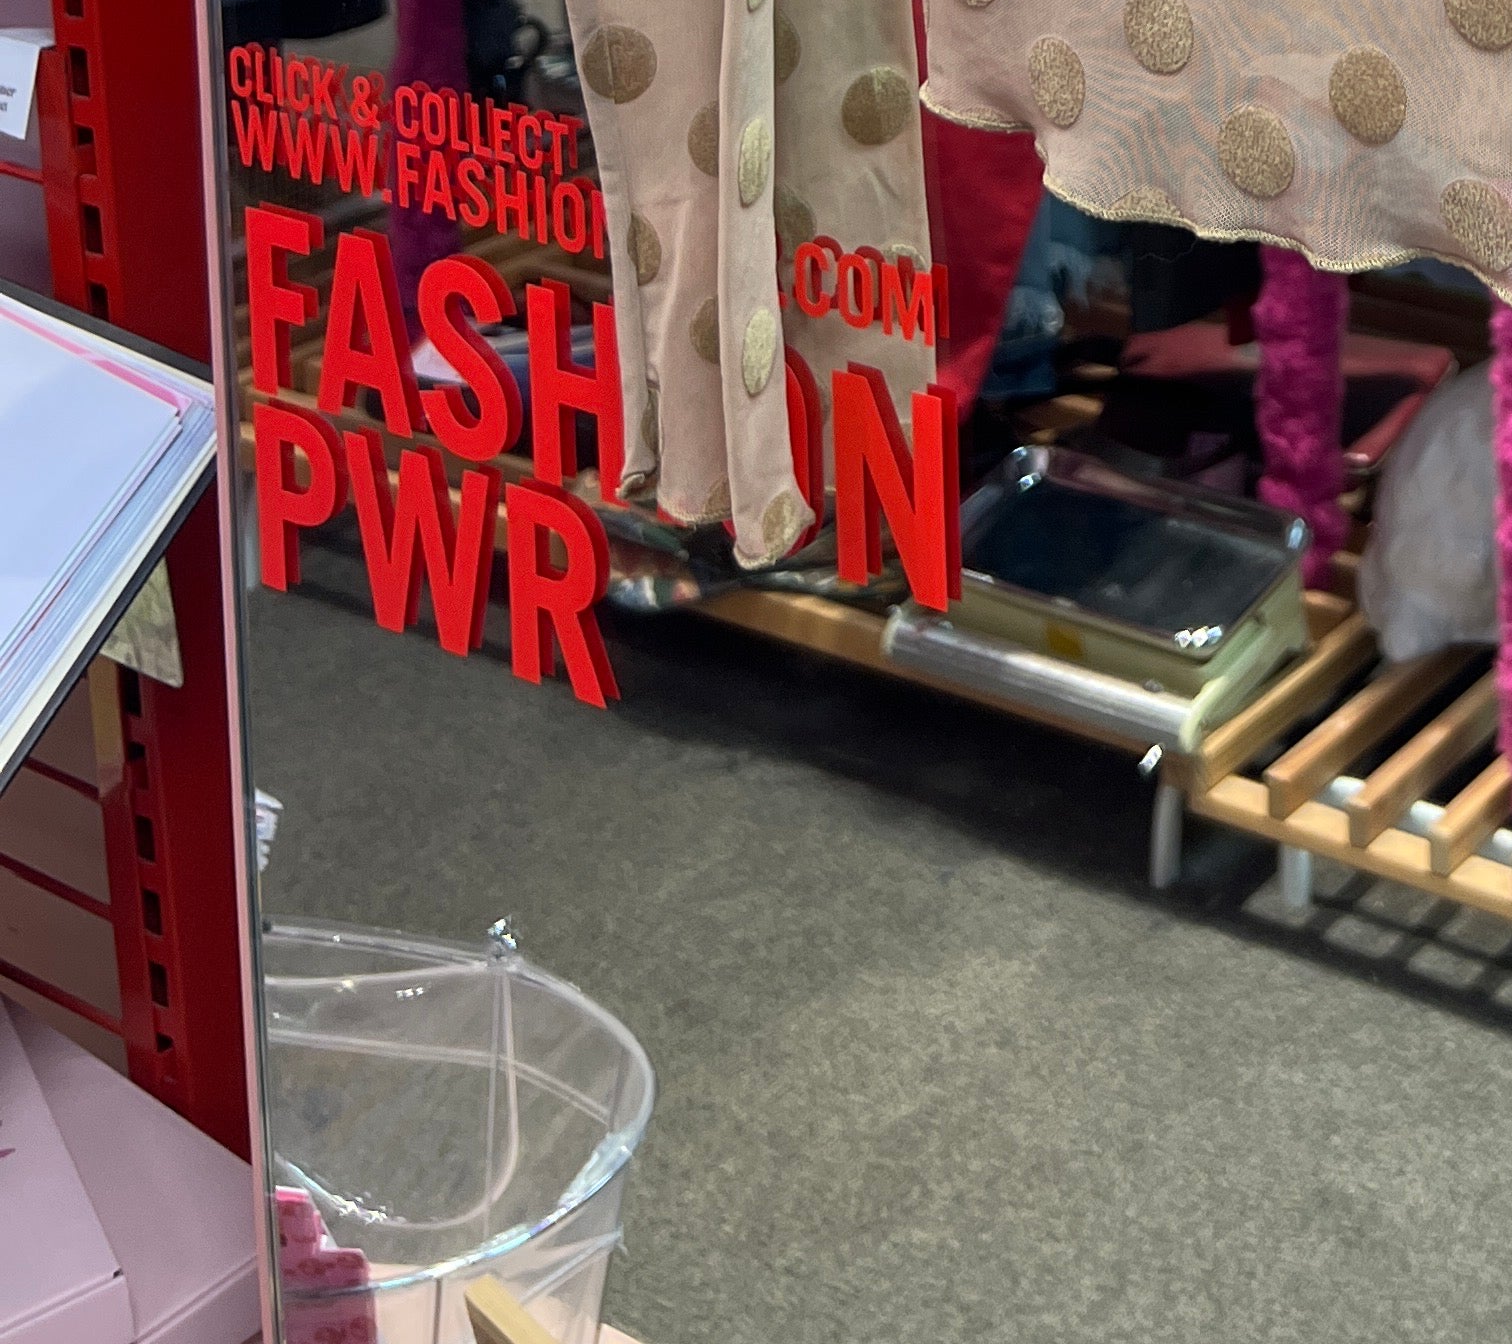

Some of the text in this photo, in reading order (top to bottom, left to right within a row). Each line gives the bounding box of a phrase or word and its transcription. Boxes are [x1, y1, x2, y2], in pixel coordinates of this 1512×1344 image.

[230, 47, 568, 176] CLICK & COLLECT
[245, 206, 948, 613] FASHN
[253, 402, 607, 709] PWR
